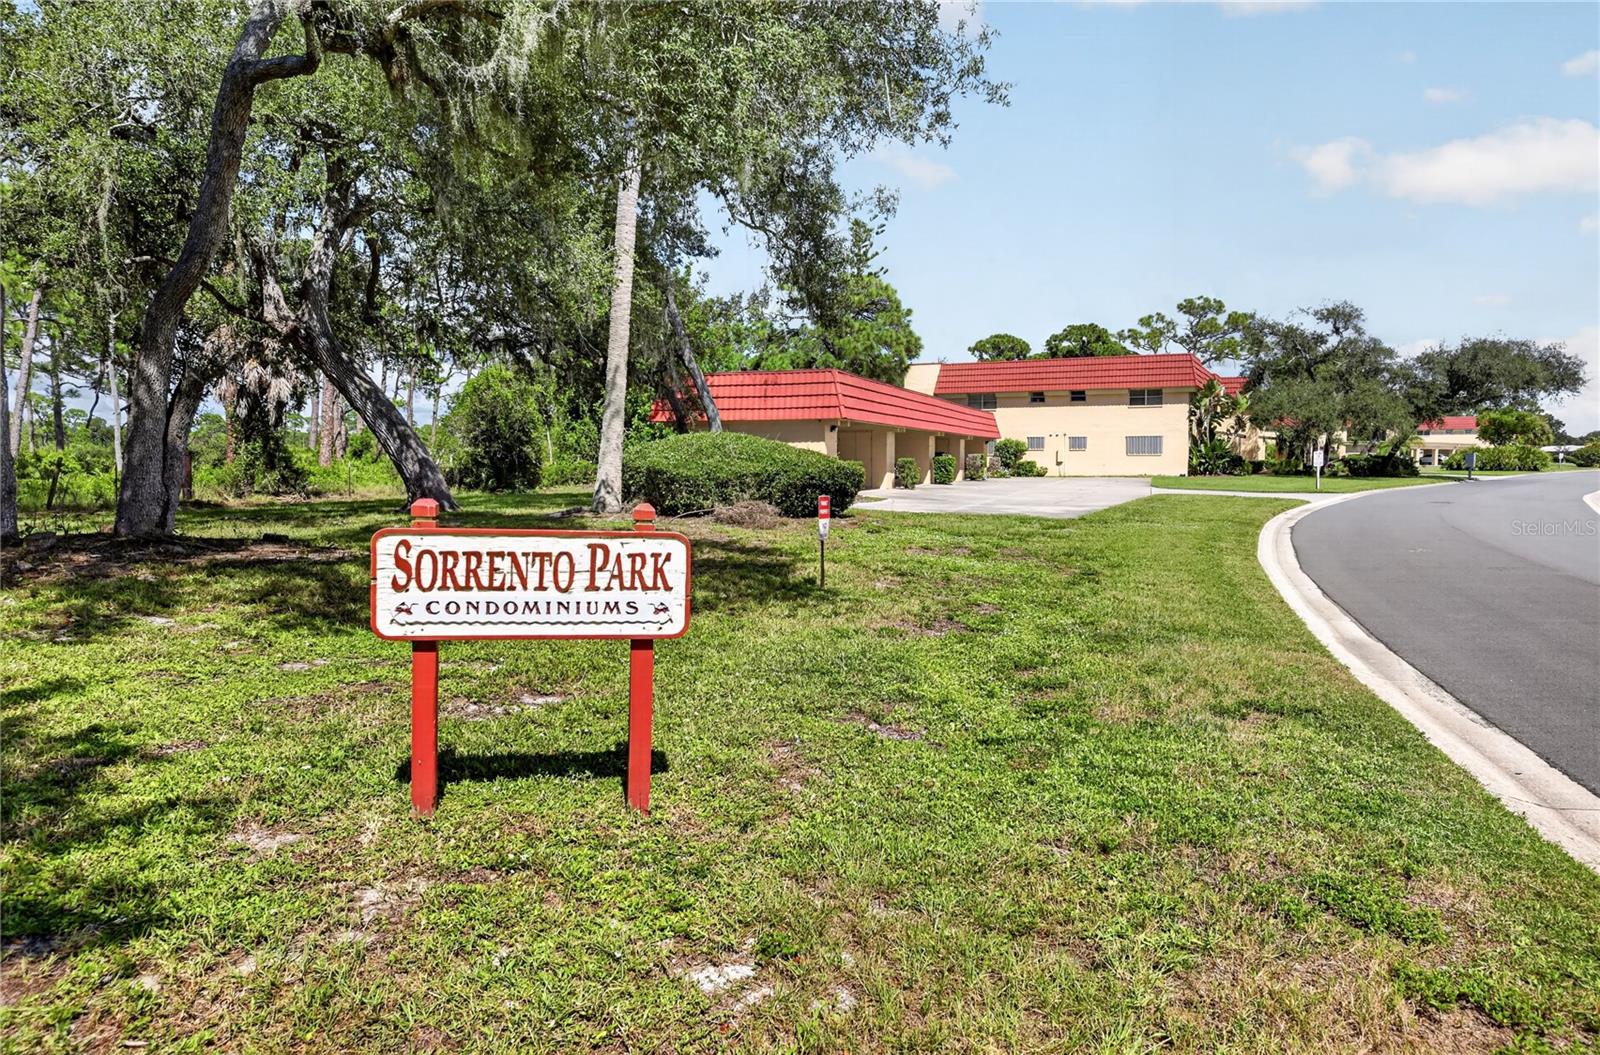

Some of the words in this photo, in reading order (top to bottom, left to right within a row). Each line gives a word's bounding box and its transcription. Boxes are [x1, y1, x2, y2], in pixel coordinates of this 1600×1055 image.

[391, 539, 575, 593] SORRENTO
[585, 542, 673, 592] PARK
[425, 600, 640, 616] CONDOMINIUMS
